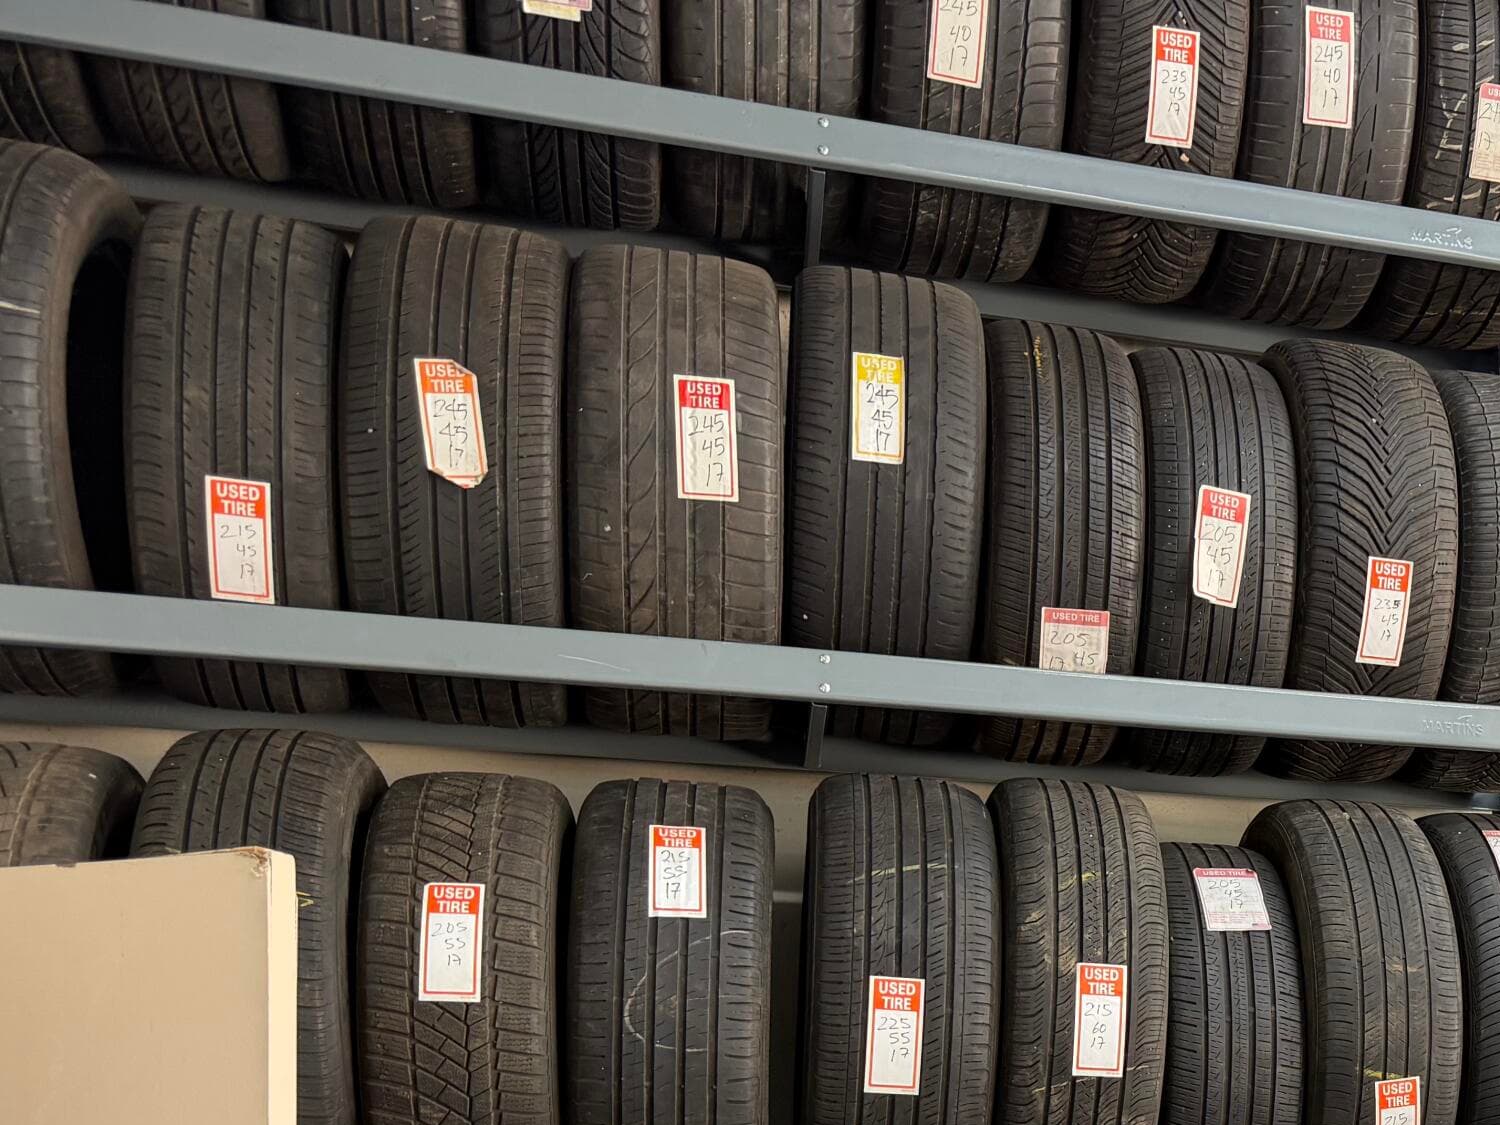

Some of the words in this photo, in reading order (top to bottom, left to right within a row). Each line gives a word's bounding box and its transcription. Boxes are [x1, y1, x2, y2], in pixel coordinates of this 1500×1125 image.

[1315, 13, 1343, 27] USED
[952, 26, 972, 43] 40
[1318, 27, 1341, 41] TIRE
[1160, 35, 1192, 48] USED
[950, 47, 968, 71] 17
[1163, 49, 1190, 62] TIRE
[1314, 46, 1342, 63] 245
[1162, 69, 1186, 84] 235
[1322, 69, 1341, 85] 40
[1170, 86, 1186, 101] 45
[1322, 89, 1338, 109] 17
[1168, 102, 1180, 115] 17
[861, 357, 896, 370] USED
[429, 379, 465, 393] TIRE
[686, 382, 721, 396] USED
[689, 395, 720, 408] TIRE
[866, 385, 897, 407] 245
[433, 400, 468, 419] 245
[702, 438, 725, 456] 45
[875, 431, 889, 452] 17
[707, 463, 723, 487] 17
[216, 482, 260, 501] USED
[1210, 492, 1240, 508] USED
[220, 500, 256, 517] TIRE
[1210, 505, 1237, 520] TIRE
[220, 525, 256, 539] 215
[1199, 524, 1236, 542] 205
[236, 544, 256, 557] 45
[1206, 547, 1231, 565] 45
[239, 563, 255, 579] 17
[1375, 562, 1405, 576] USED
[1377, 577, 1403, 590] TIRE
[1374, 599, 1400, 610] 235
[1052, 612, 1076, 622] USED
[1078, 613, 1100, 623] TIRE
[1382, 613, 1398, 625] 45
[1050, 631, 1089, 646] 205
[1380, 630, 1391, 641] 17
[658, 828, 696, 837] USED
[663, 839, 692, 848] TIRE
[661, 850, 690, 863] 215
[663, 866, 688, 879] 55
[1208, 879, 1240, 889] 205
[434, 886, 474, 899] USED
[666, 883, 681, 900] 17
[437, 900, 469, 913] TIRE
[432, 922, 467, 936] 205
[444, 938, 465, 949] 55
[1085, 968, 1118, 981] USED
[879, 983, 916, 995] USED
[1088, 982, 1115, 994] TIRE
[880, 996, 912, 1010] TIRE
[1084, 1002, 1112, 1017] 215
[877, 1016, 911, 1031] 225
[1092, 1022, 1106, 1034] 60
[889, 1033, 910, 1045] 55
[1090, 1037, 1106, 1049] 17
[890, 1049, 909, 1062] 17
[1383, 1081, 1412, 1096] USED
[1385, 1094, 1409, 1106] TIRE
